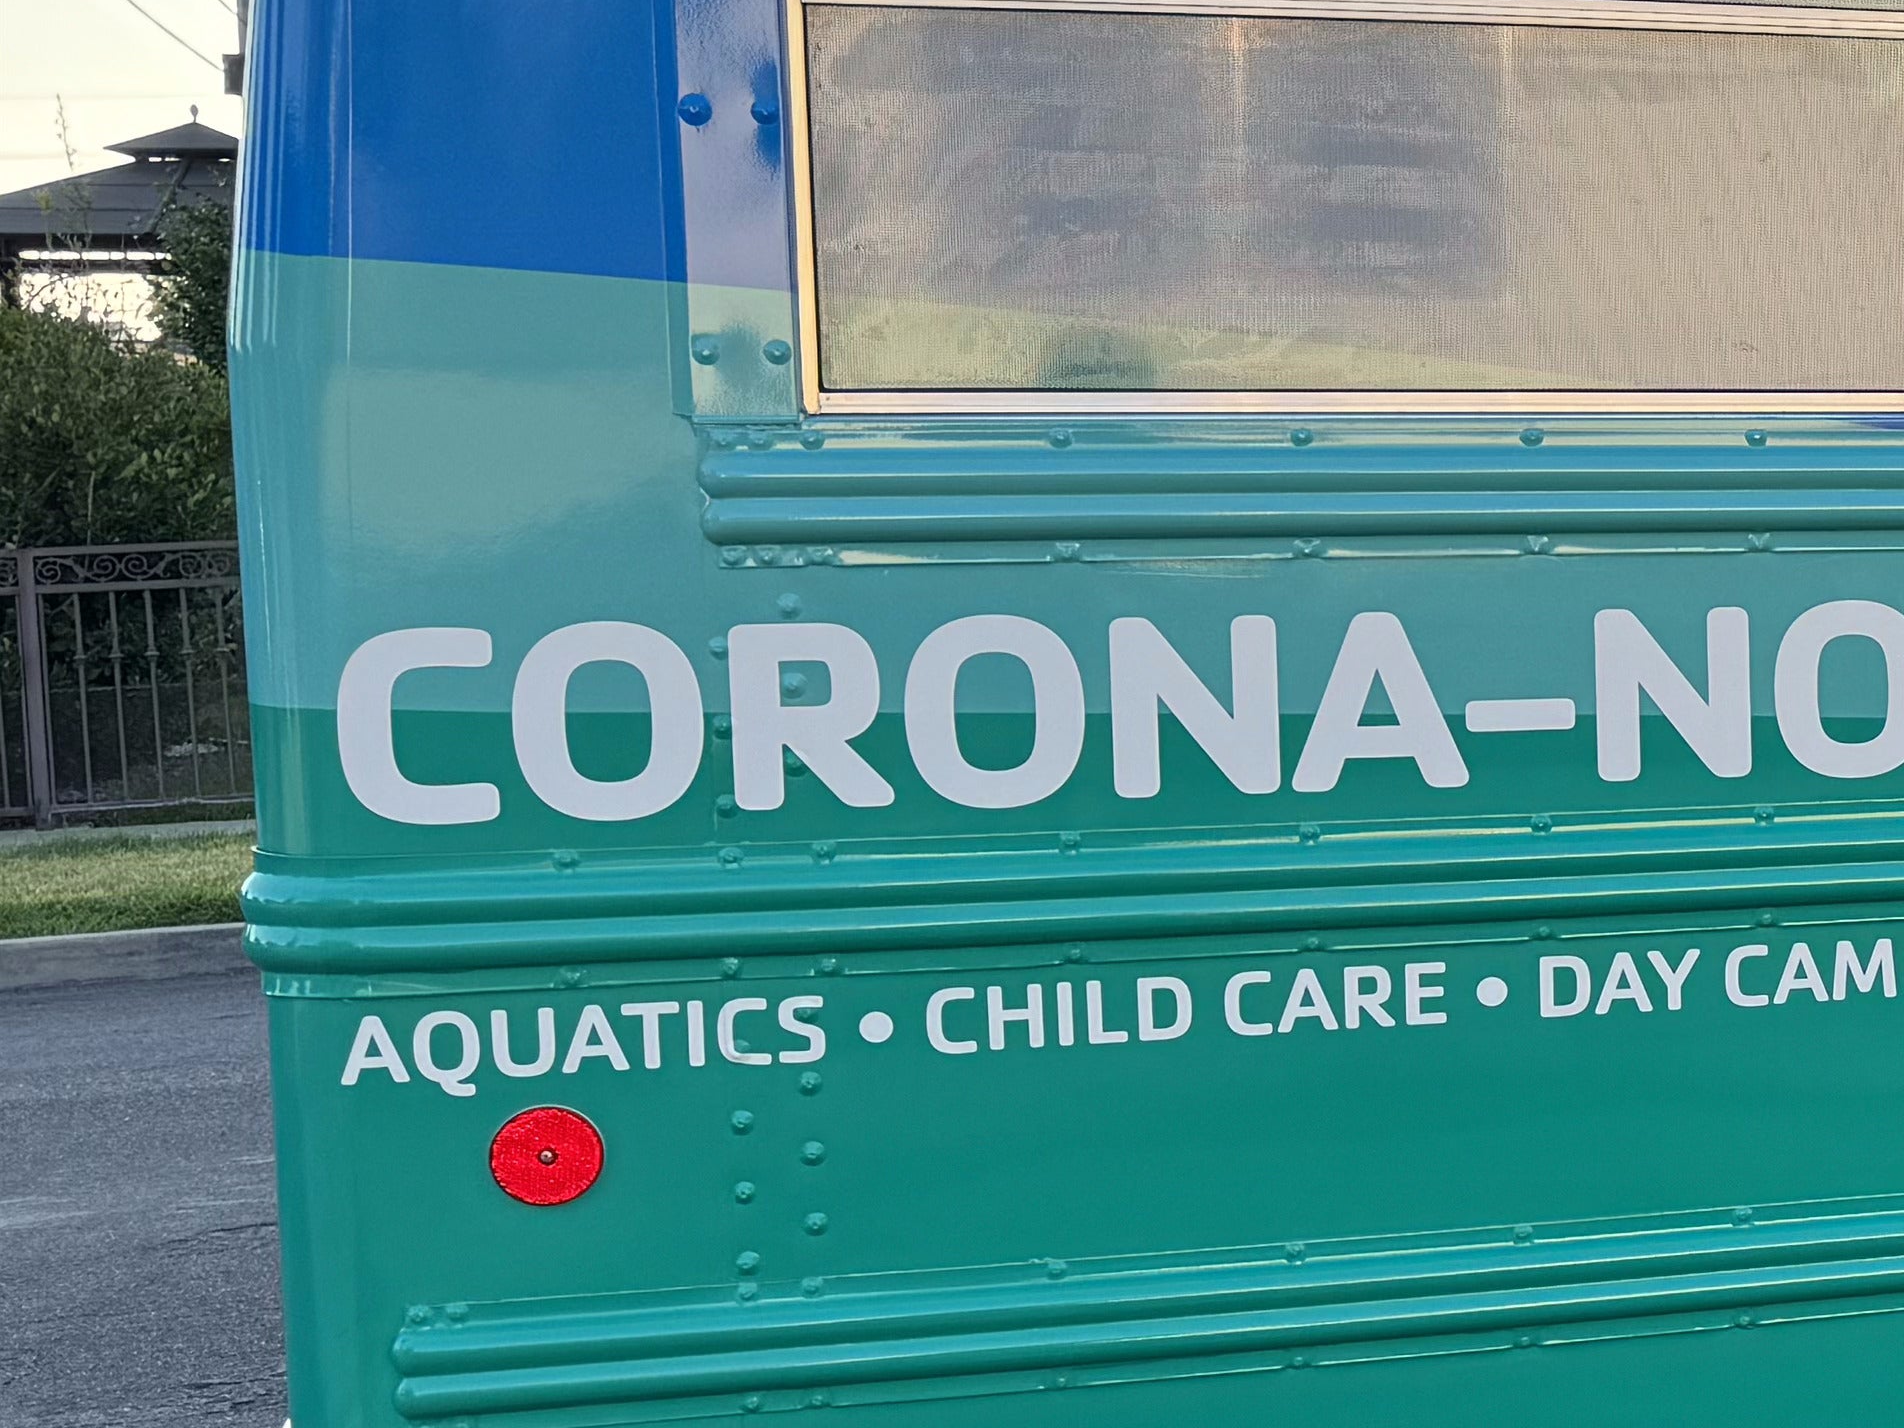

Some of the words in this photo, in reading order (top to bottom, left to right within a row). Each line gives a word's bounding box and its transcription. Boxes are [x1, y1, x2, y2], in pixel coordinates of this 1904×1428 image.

[341, 995, 826, 1097] AQUATICS
[926, 976, 1193, 1055] CHILD
[1224, 961, 1448, 1036] CARE
[1539, 948, 1701, 1018] DAY
